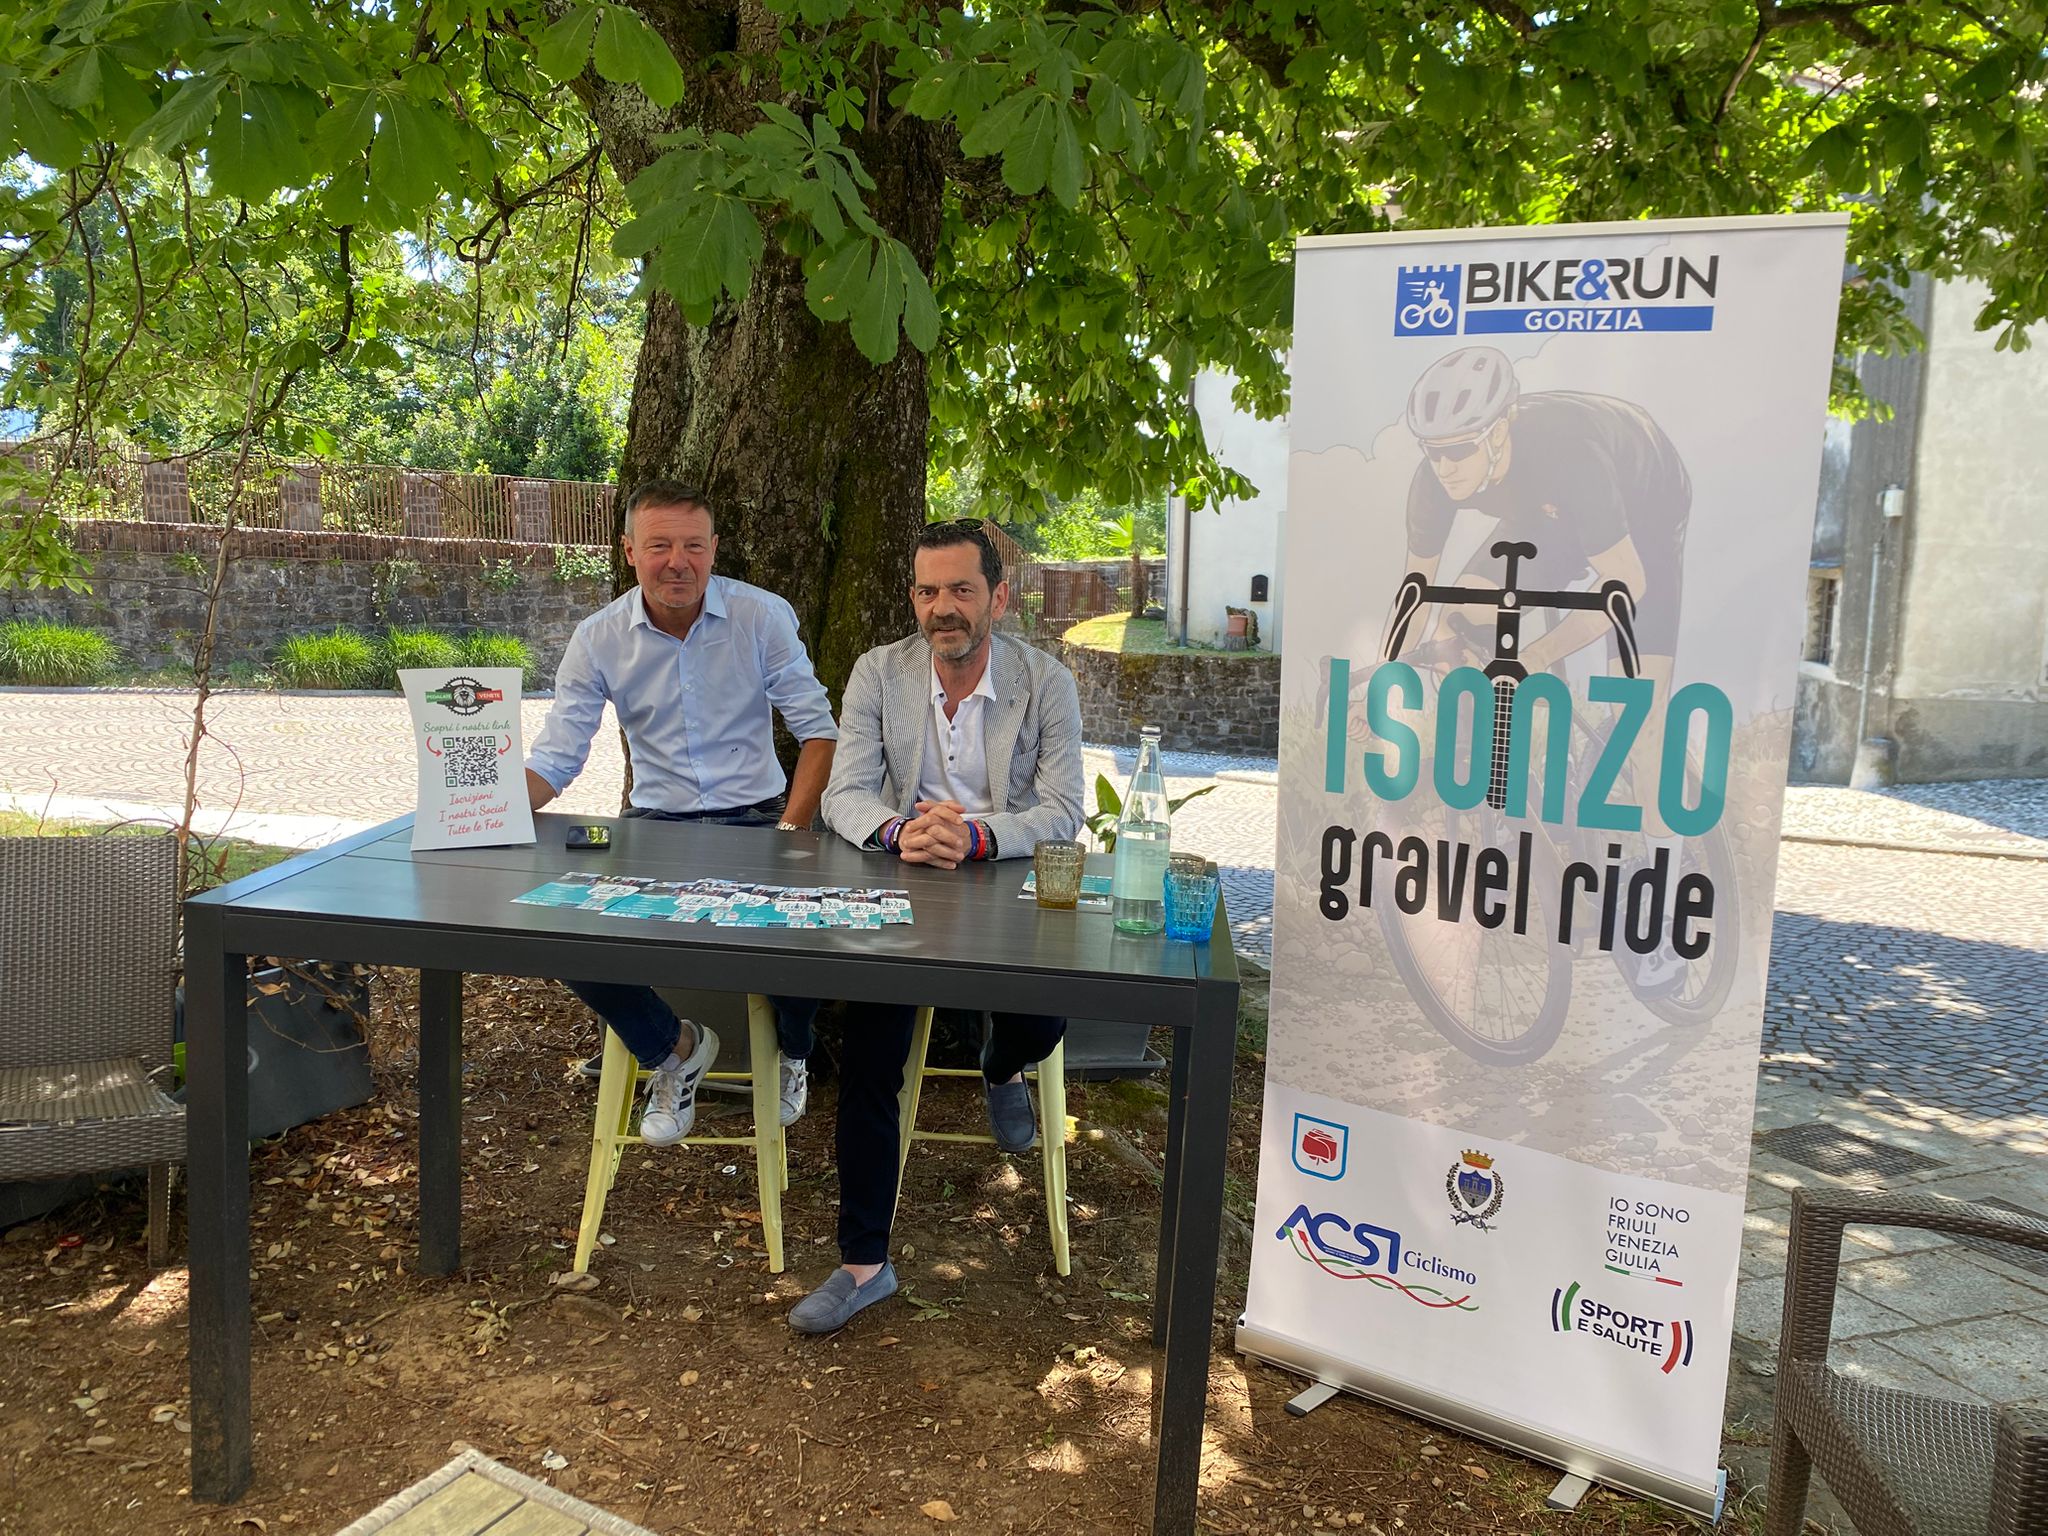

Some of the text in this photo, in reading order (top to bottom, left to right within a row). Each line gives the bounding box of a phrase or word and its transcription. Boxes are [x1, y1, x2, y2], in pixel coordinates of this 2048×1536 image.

[1465, 255, 1719, 304] BIKE&RUN
[1524, 309, 1644, 331] GORIZIA
[423, 719, 511, 734] Scopri i nostri link
[1325, 658, 1733, 837] ISONZO
[449, 790, 494, 805] Iscrizioni
[439, 801, 509, 822] I nostri Social
[447, 818, 504, 836] Tutte le Foto
[1319, 825, 1715, 960] gravel ride
[1610, 1197, 1690, 1223] IO SONO
[1608, 1214, 1656, 1235] FRIULI
[1275, 1204, 1401, 1274] ACSI
[1606, 1230, 1679, 1258] VENEZIA
[1403, 1250, 1477, 1285] Ciclismo
[1605, 1248, 1661, 1272] GIULIA
[1580, 1298, 1664, 1339] SPORT
[1577, 1318, 1663, 1357] E SALUTE
